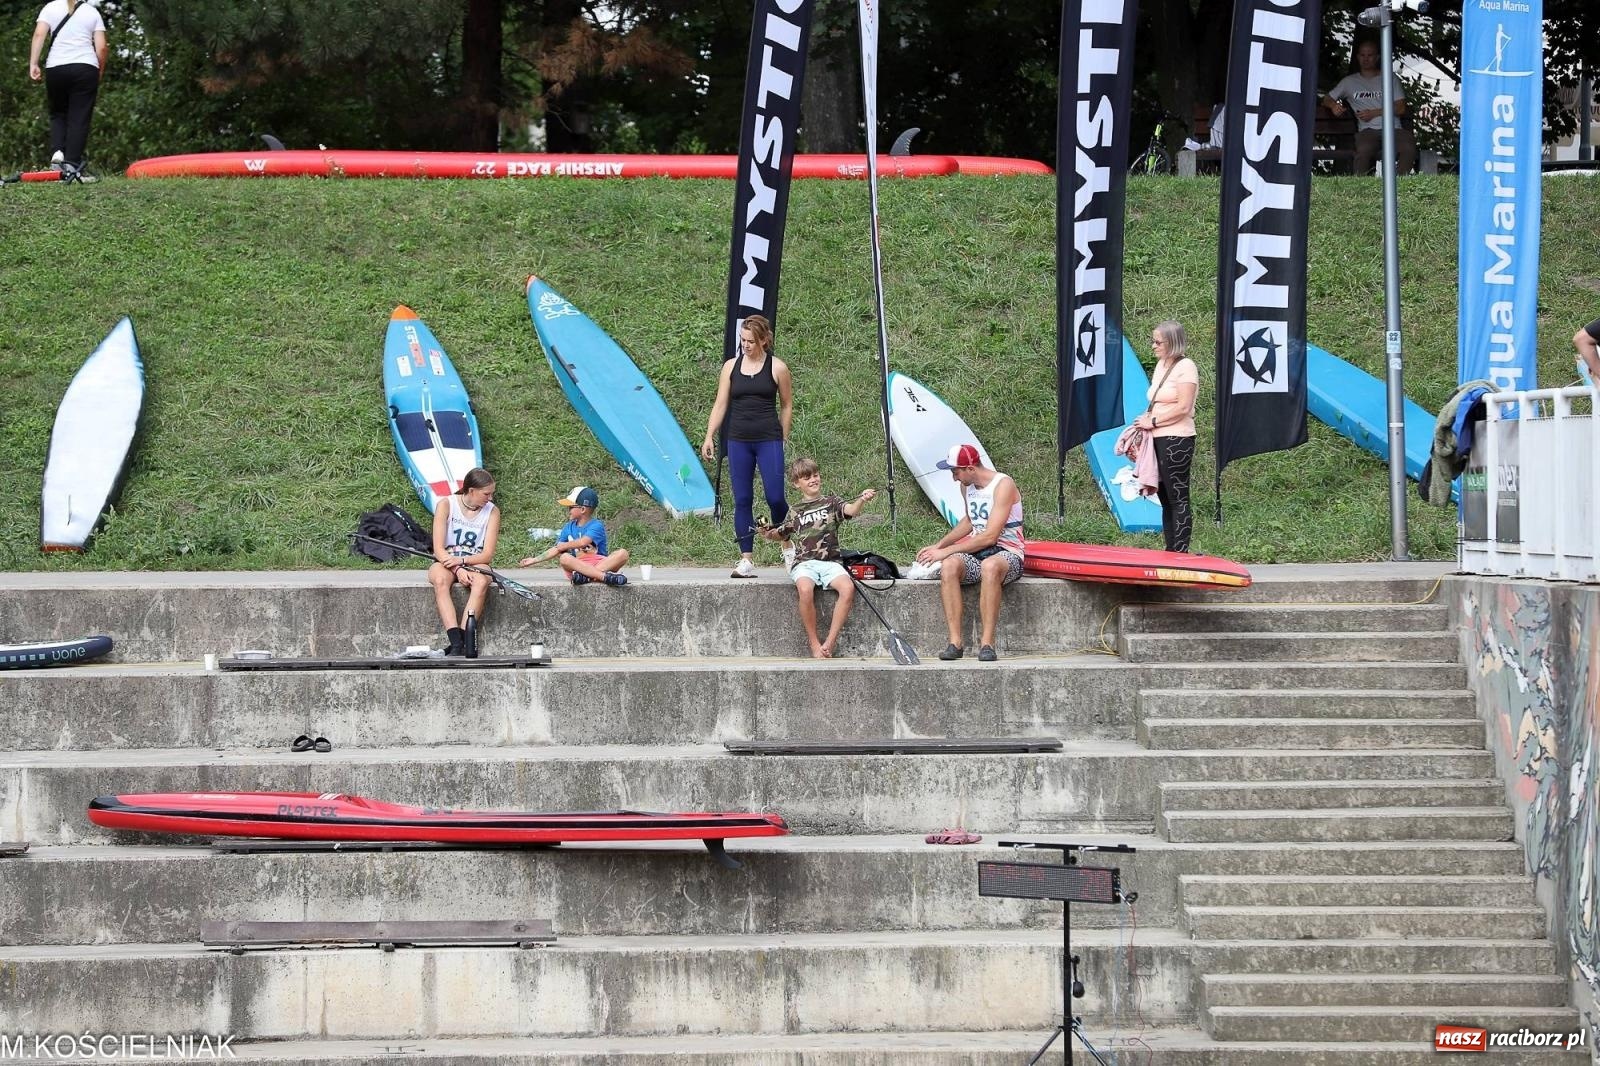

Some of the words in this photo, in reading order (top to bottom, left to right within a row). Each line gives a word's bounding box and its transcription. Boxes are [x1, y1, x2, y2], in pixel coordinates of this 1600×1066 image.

[1502, 0, 1530, 13] Marina
[1234, 0, 1305, 308] MYSTI
[506, 162, 551, 175] RACE
[555, 162, 624, 176] AIRSHIP
[1484, 94, 1516, 285] Marina
[1489, 302, 1523, 411] qua
[798, 506, 830, 526] VANS
[970, 501, 989, 521] 36
[453, 528, 478, 547] 18
